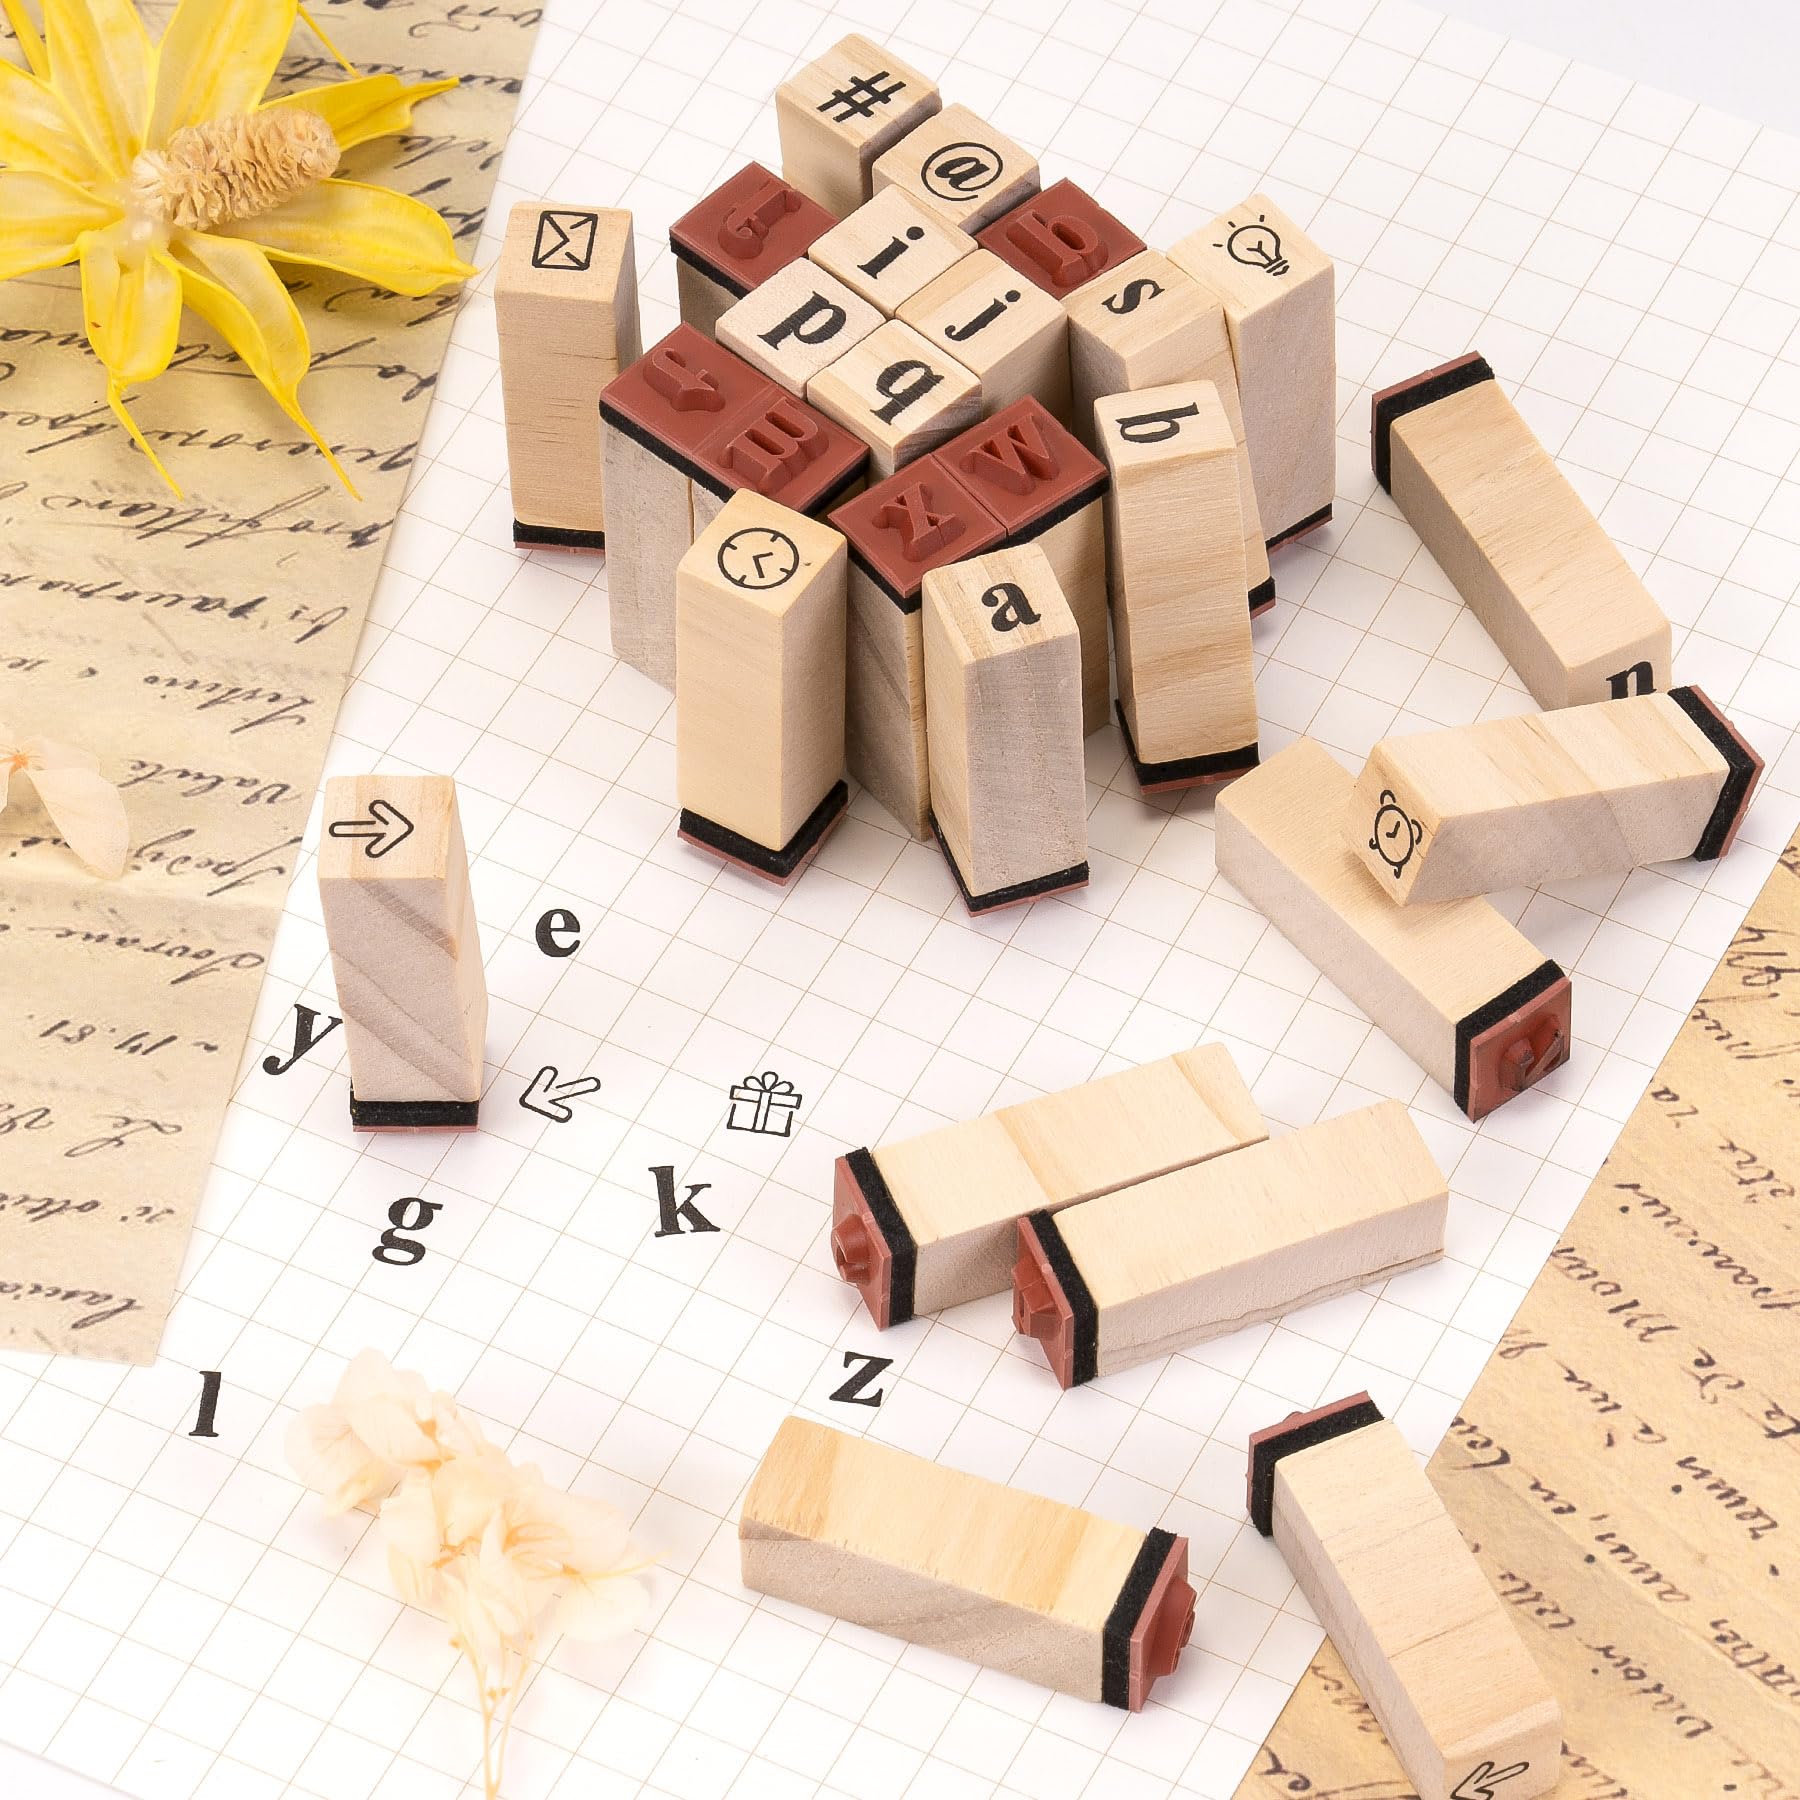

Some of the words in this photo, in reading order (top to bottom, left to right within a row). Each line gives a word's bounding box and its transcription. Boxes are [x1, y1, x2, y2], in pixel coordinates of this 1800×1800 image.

[921, 142, 1003, 201] @
[857, 226, 925, 280] i
[757, 291, 847, 351] p
[944, 290, 1021, 342] j
[1102, 279, 1166, 315] s
[871, 360, 944, 425] q
[1115, 402, 1199, 444] b
[981, 582, 1042, 632] a
[1606, 661, 1657, 700] n
[535, 908, 581, 958] e
[262, 1003, 344, 1076] y
[648, 1165, 721, 1238] k
[372, 1197, 444, 1266] g
[188, 1370, 222, 1438] l
[829, 1351, 894, 1408] z
